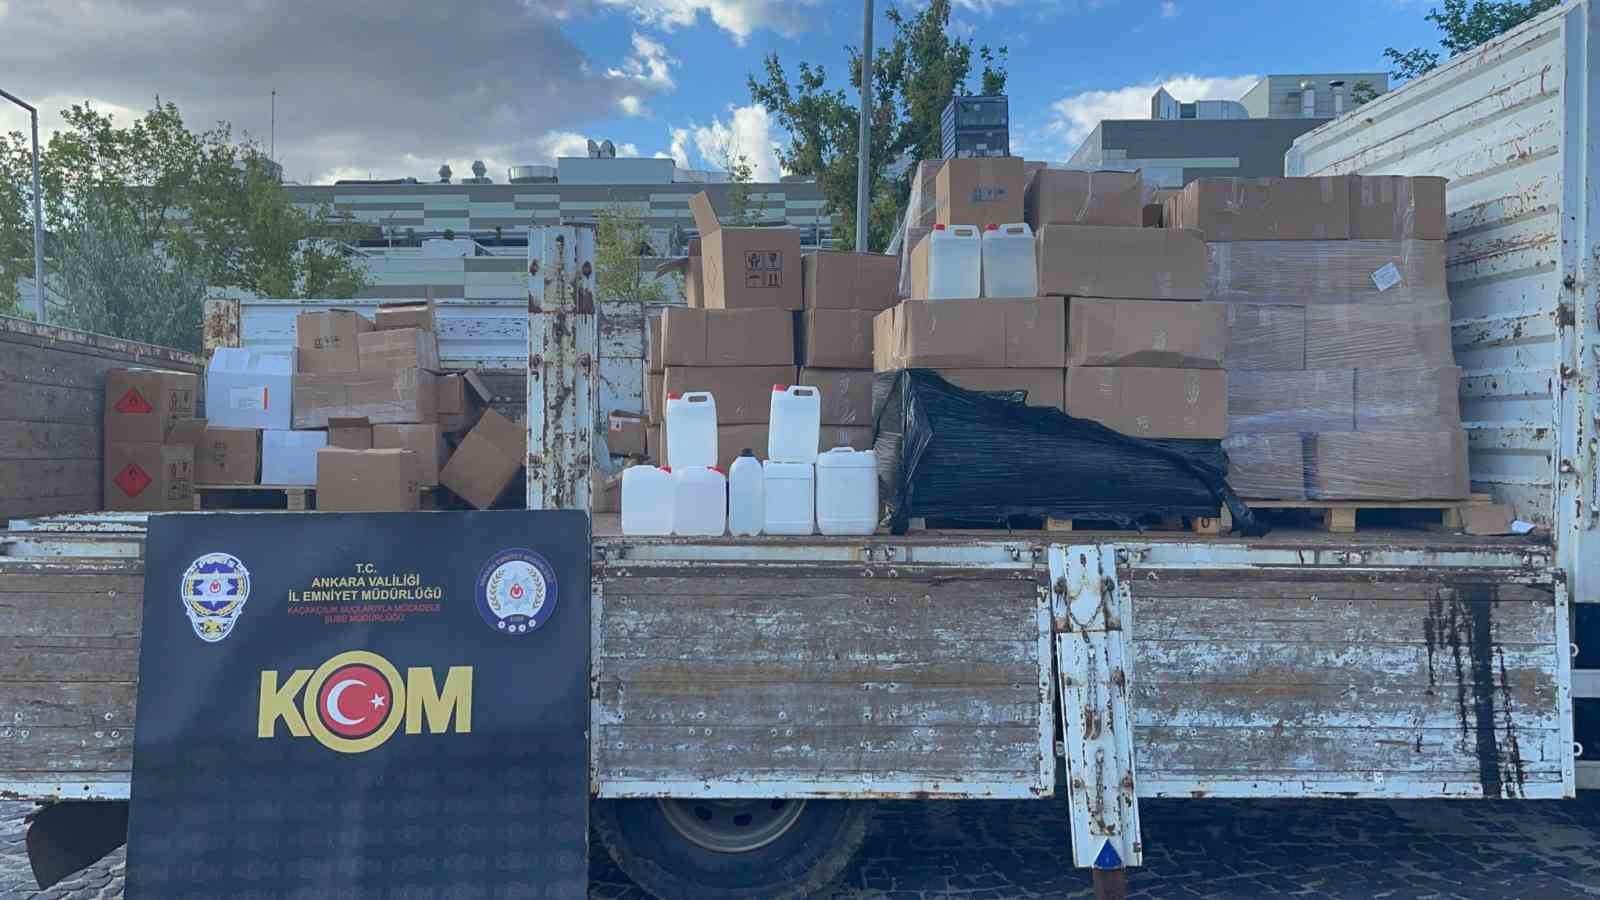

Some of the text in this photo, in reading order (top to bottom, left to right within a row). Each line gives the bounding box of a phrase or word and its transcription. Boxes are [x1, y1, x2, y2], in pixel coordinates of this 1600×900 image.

[355, 563, 377, 574] T.C.
[312, 574, 420, 587] ANKARA VALİLİĞİ
[288, 586, 442, 601] İL EMNİYET MÜDÜRLÜĞÜ
[257, 650, 474, 754] KOM
